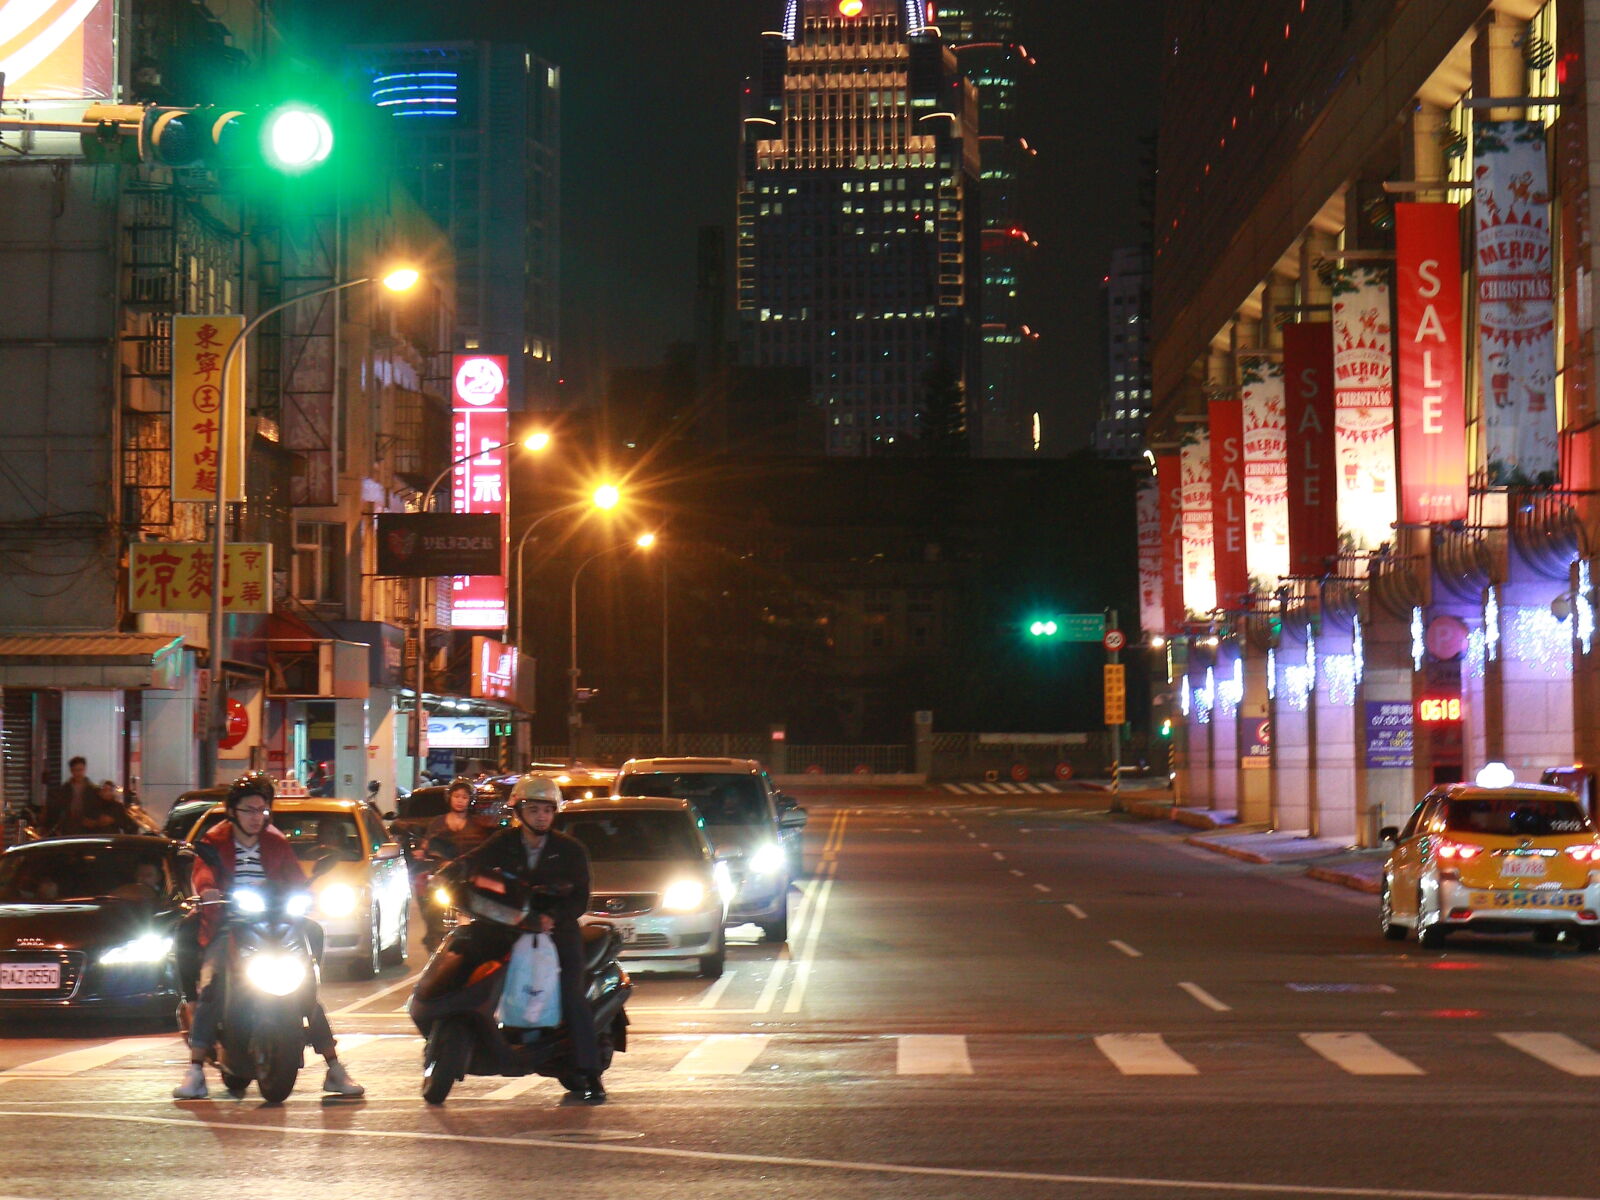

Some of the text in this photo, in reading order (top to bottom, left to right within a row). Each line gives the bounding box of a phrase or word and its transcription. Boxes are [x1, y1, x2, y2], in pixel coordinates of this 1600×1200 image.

[1480, 241, 1549, 266] MERRY
[1480, 279, 1550, 299] CHRISTMAS
[1414, 259, 1447, 434] SALE
[1336, 361, 1393, 380] MERRY
[1335, 391, 1392, 407] CHRISTMAS
[1298, 367, 1323, 506] SALE
[1221, 438, 1243, 552] SALE
